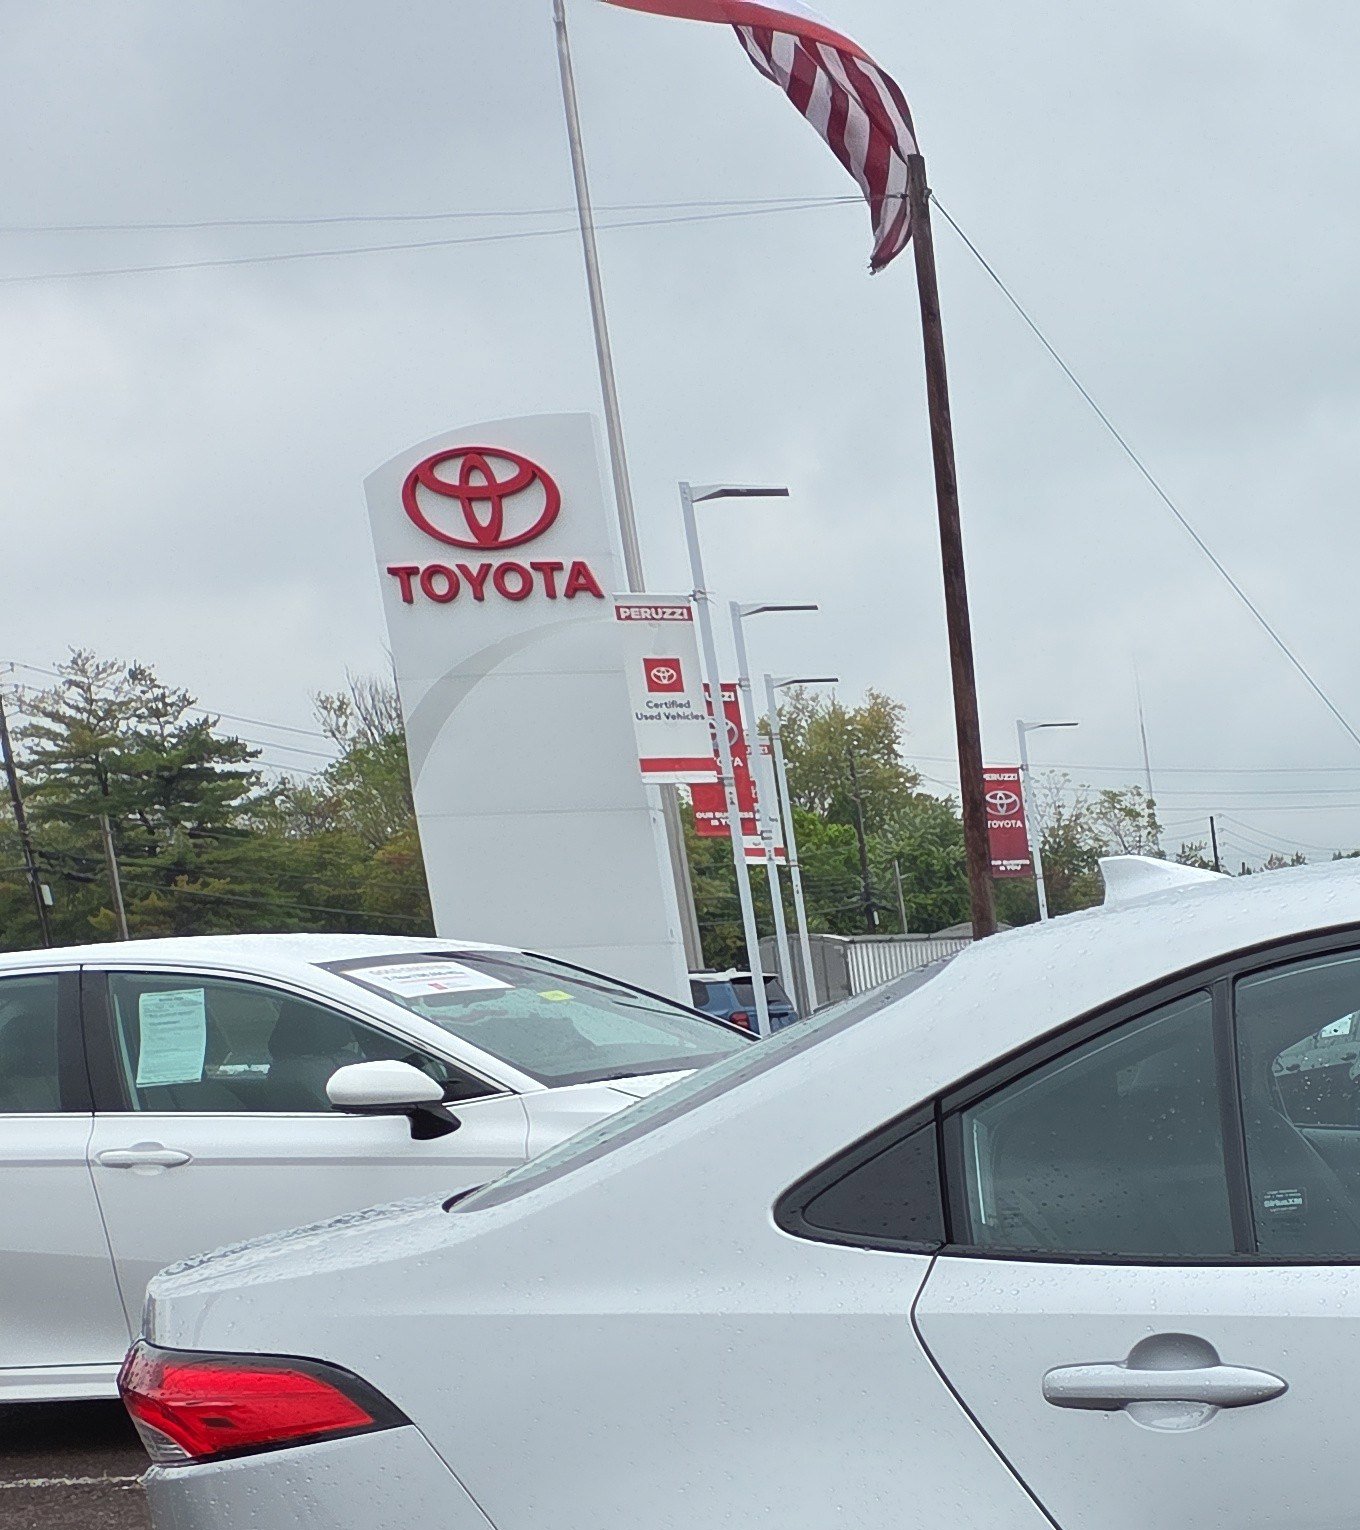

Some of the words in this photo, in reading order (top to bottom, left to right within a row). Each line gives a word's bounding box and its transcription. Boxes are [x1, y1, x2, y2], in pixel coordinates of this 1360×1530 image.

[387, 560, 605, 604] TOYOTA
[620, 607, 689, 620] PERUZZI
[645, 699, 691, 710] Certified
[635, 711, 662, 721] Used
[663, 711, 705, 721] Vehicles
[987, 820, 1023, 829] TOYOTA
